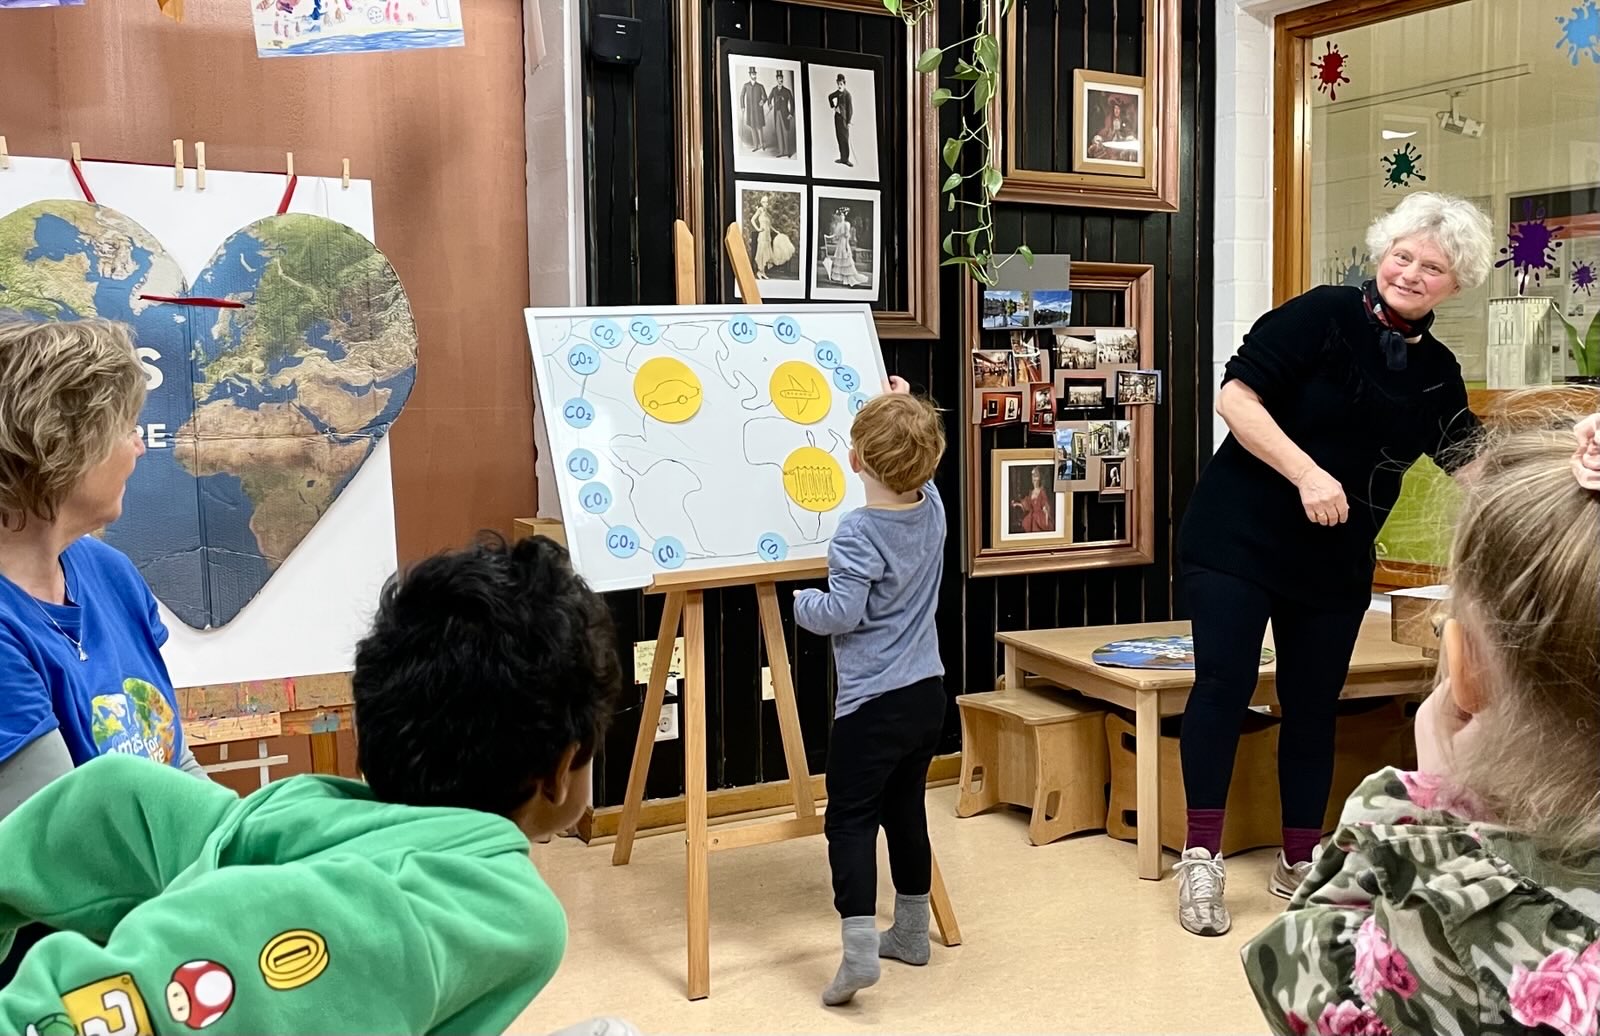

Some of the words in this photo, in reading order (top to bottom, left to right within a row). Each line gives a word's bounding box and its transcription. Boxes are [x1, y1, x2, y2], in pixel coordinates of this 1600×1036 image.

[594, 325, 616, 346] CO2
[631, 321, 653, 341] CO2
[569, 351, 593, 367] CO2
[835, 366, 854, 390] CO2
[564, 405, 592, 421] CO2
[568, 457, 594, 474] CO2
[608, 534, 634, 550] CO2
